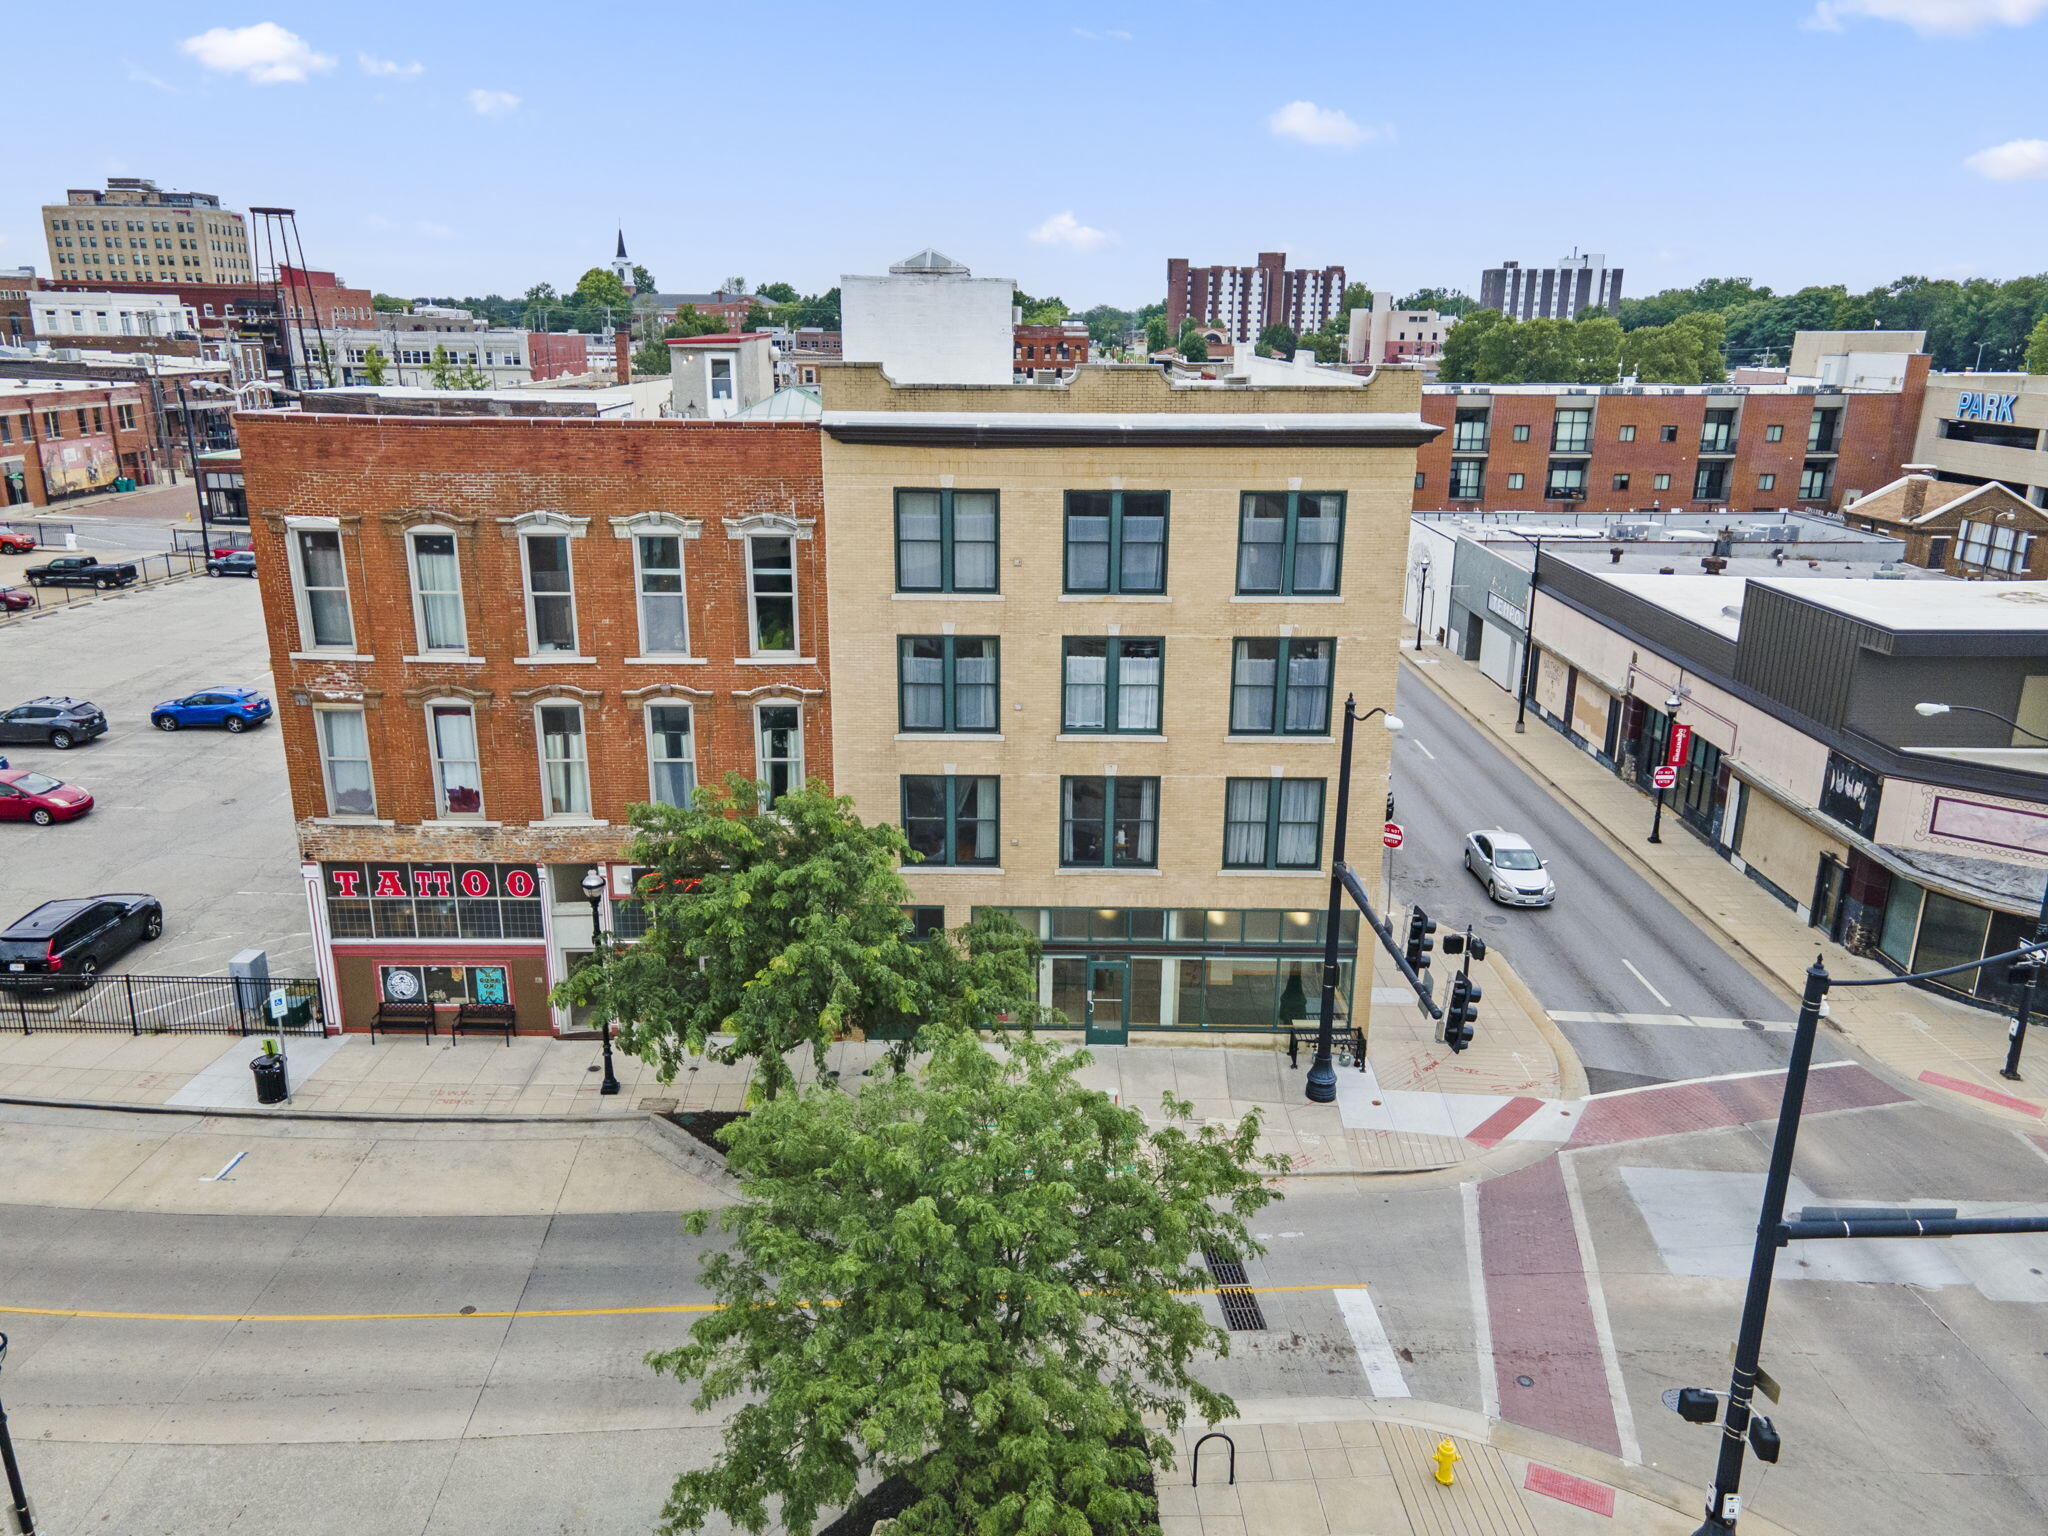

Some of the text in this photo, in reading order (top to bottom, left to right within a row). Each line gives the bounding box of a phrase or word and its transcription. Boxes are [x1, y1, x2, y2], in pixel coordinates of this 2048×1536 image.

[1956, 391, 2018, 423] PARK
[1491, 596, 1521, 625] TEMPO
[333, 870, 535, 897] TATTOO
